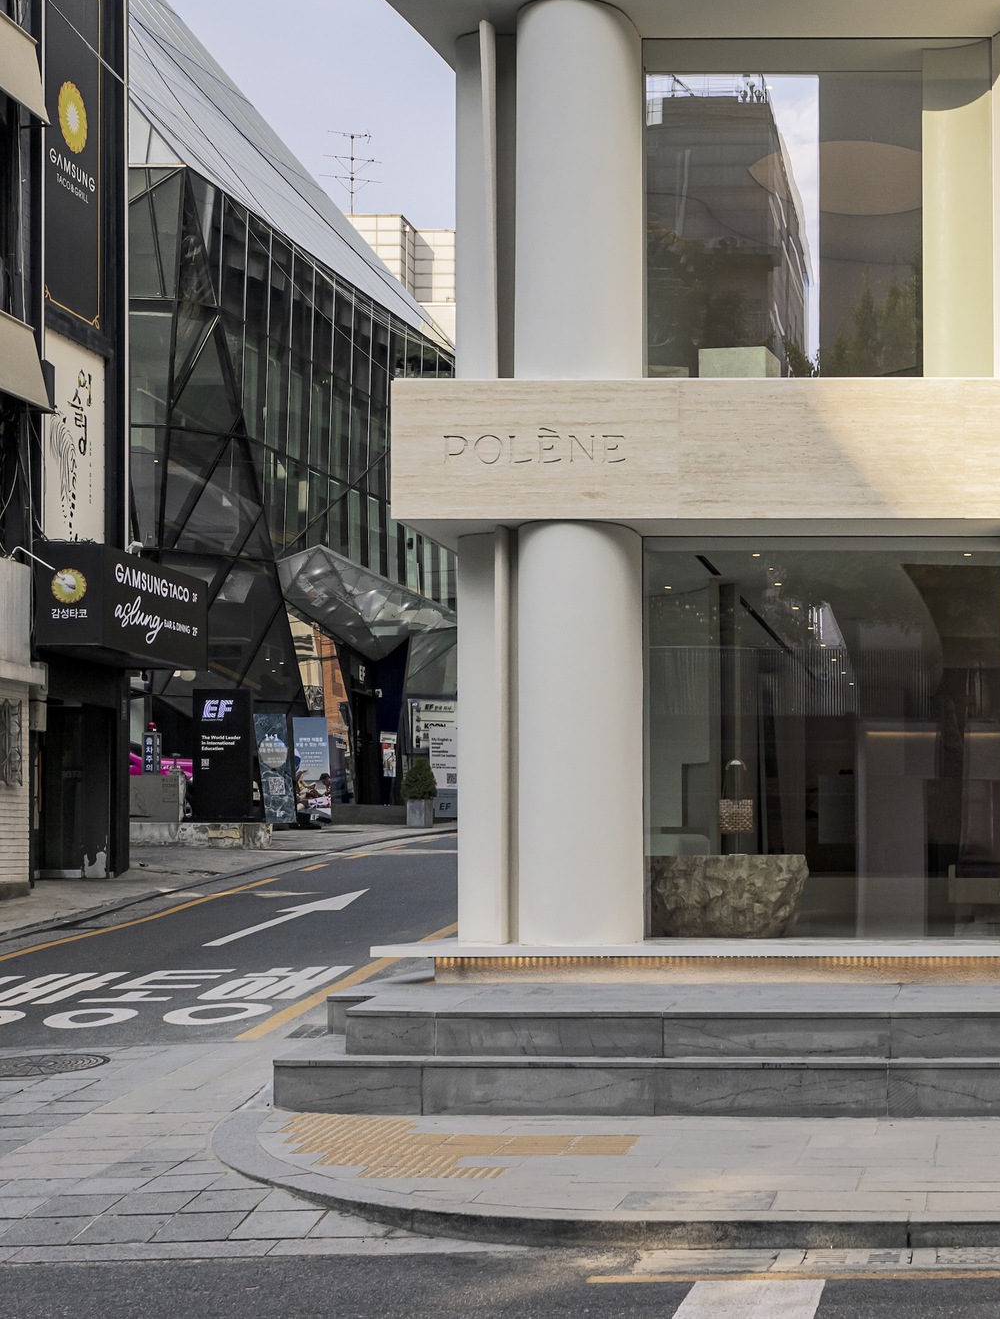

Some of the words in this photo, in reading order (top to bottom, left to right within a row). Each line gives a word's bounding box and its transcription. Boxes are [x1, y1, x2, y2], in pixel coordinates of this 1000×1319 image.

[49, 147, 96, 192] GAMSUNG
[443, 427, 627, 465] POLÈNE
[51, 609, 88, 619] 감성타코
[202, 700, 234, 718] EF
[0, 965, 355, 1029] 방통행
